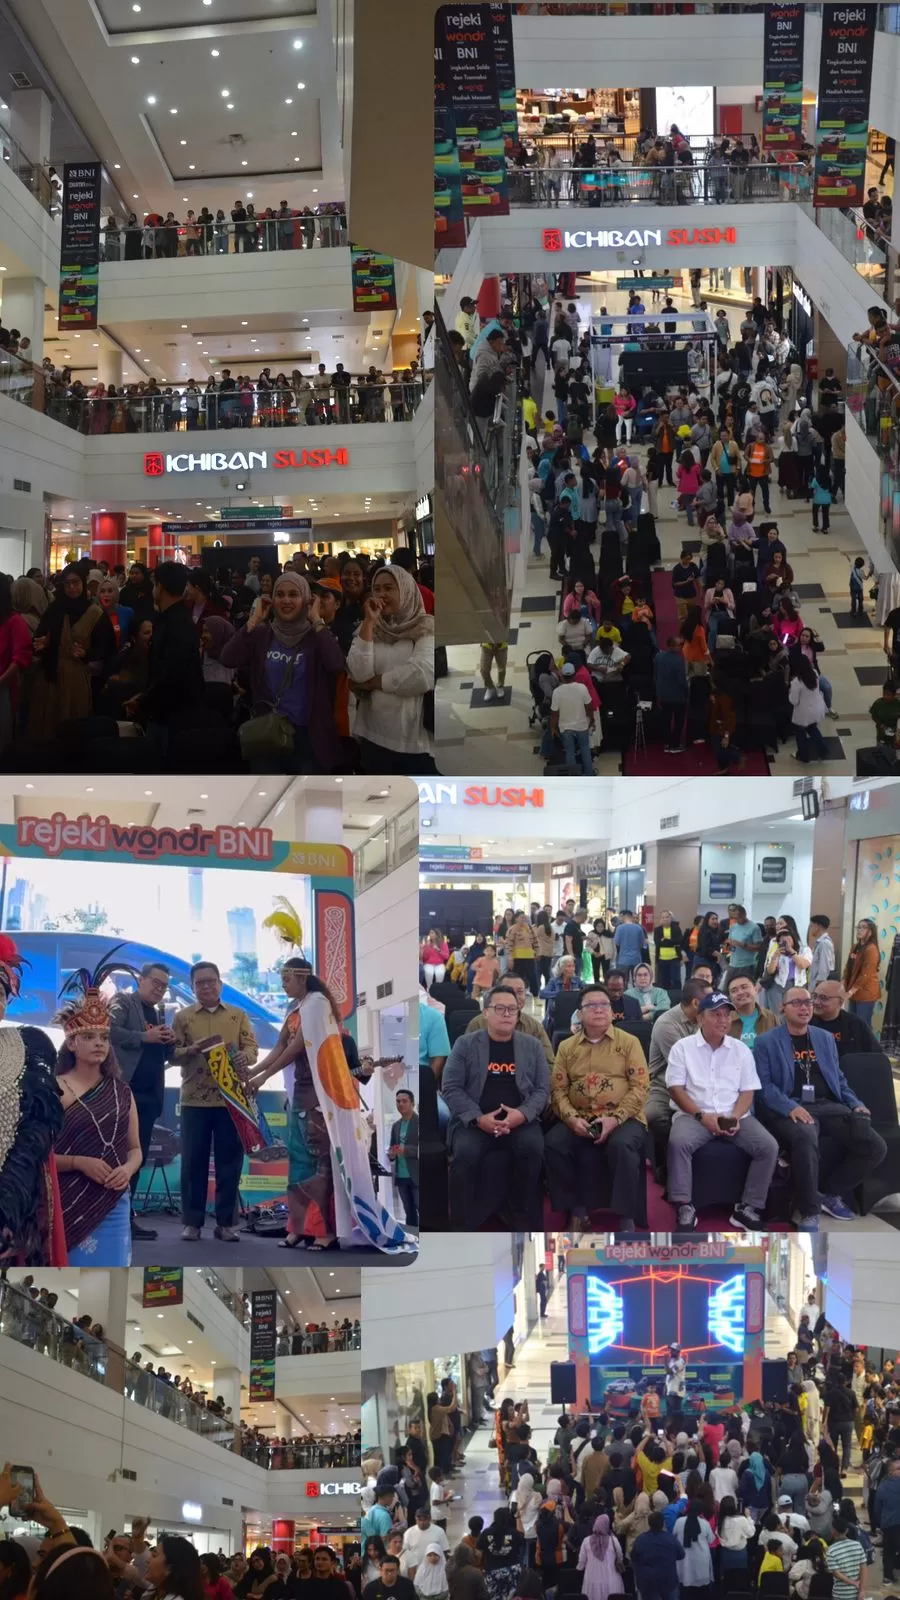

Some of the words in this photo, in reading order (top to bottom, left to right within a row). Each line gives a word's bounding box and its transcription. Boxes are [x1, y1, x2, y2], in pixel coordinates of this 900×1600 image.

[447, 14, 482, 28] rejeki
[771, 11, 800, 19] wondr
[834, 9, 866, 24] rejeki
[777, 22, 792, 30] BNI
[829, 26, 868, 39] wondr
[447, 31, 486, 44] wondr
[457, 48, 478, 59] BNI
[838, 43, 857, 53] BNI
[78, 168, 95, 176] BNI
[70, 190, 93, 202] rejeki
[74, 212, 88, 220] BNI
[565, 229, 661, 248] ICHIBAN
[667, 227, 736, 246] SUSHI
[167, 451, 266, 472] ICHIBAN
[273, 448, 348, 468] SUSHI
[464, 786, 544, 808] SUSHI
[19, 815, 106, 853] rejeki
[112, 826, 212, 855] wondr
[218, 829, 270, 857] BNI
[307, 852, 337, 868] BNI
[606, 1241, 646, 1262] rejeki
[649, 1242, 697, 1260] wondr
[700, 1243, 725, 1257] BNI
